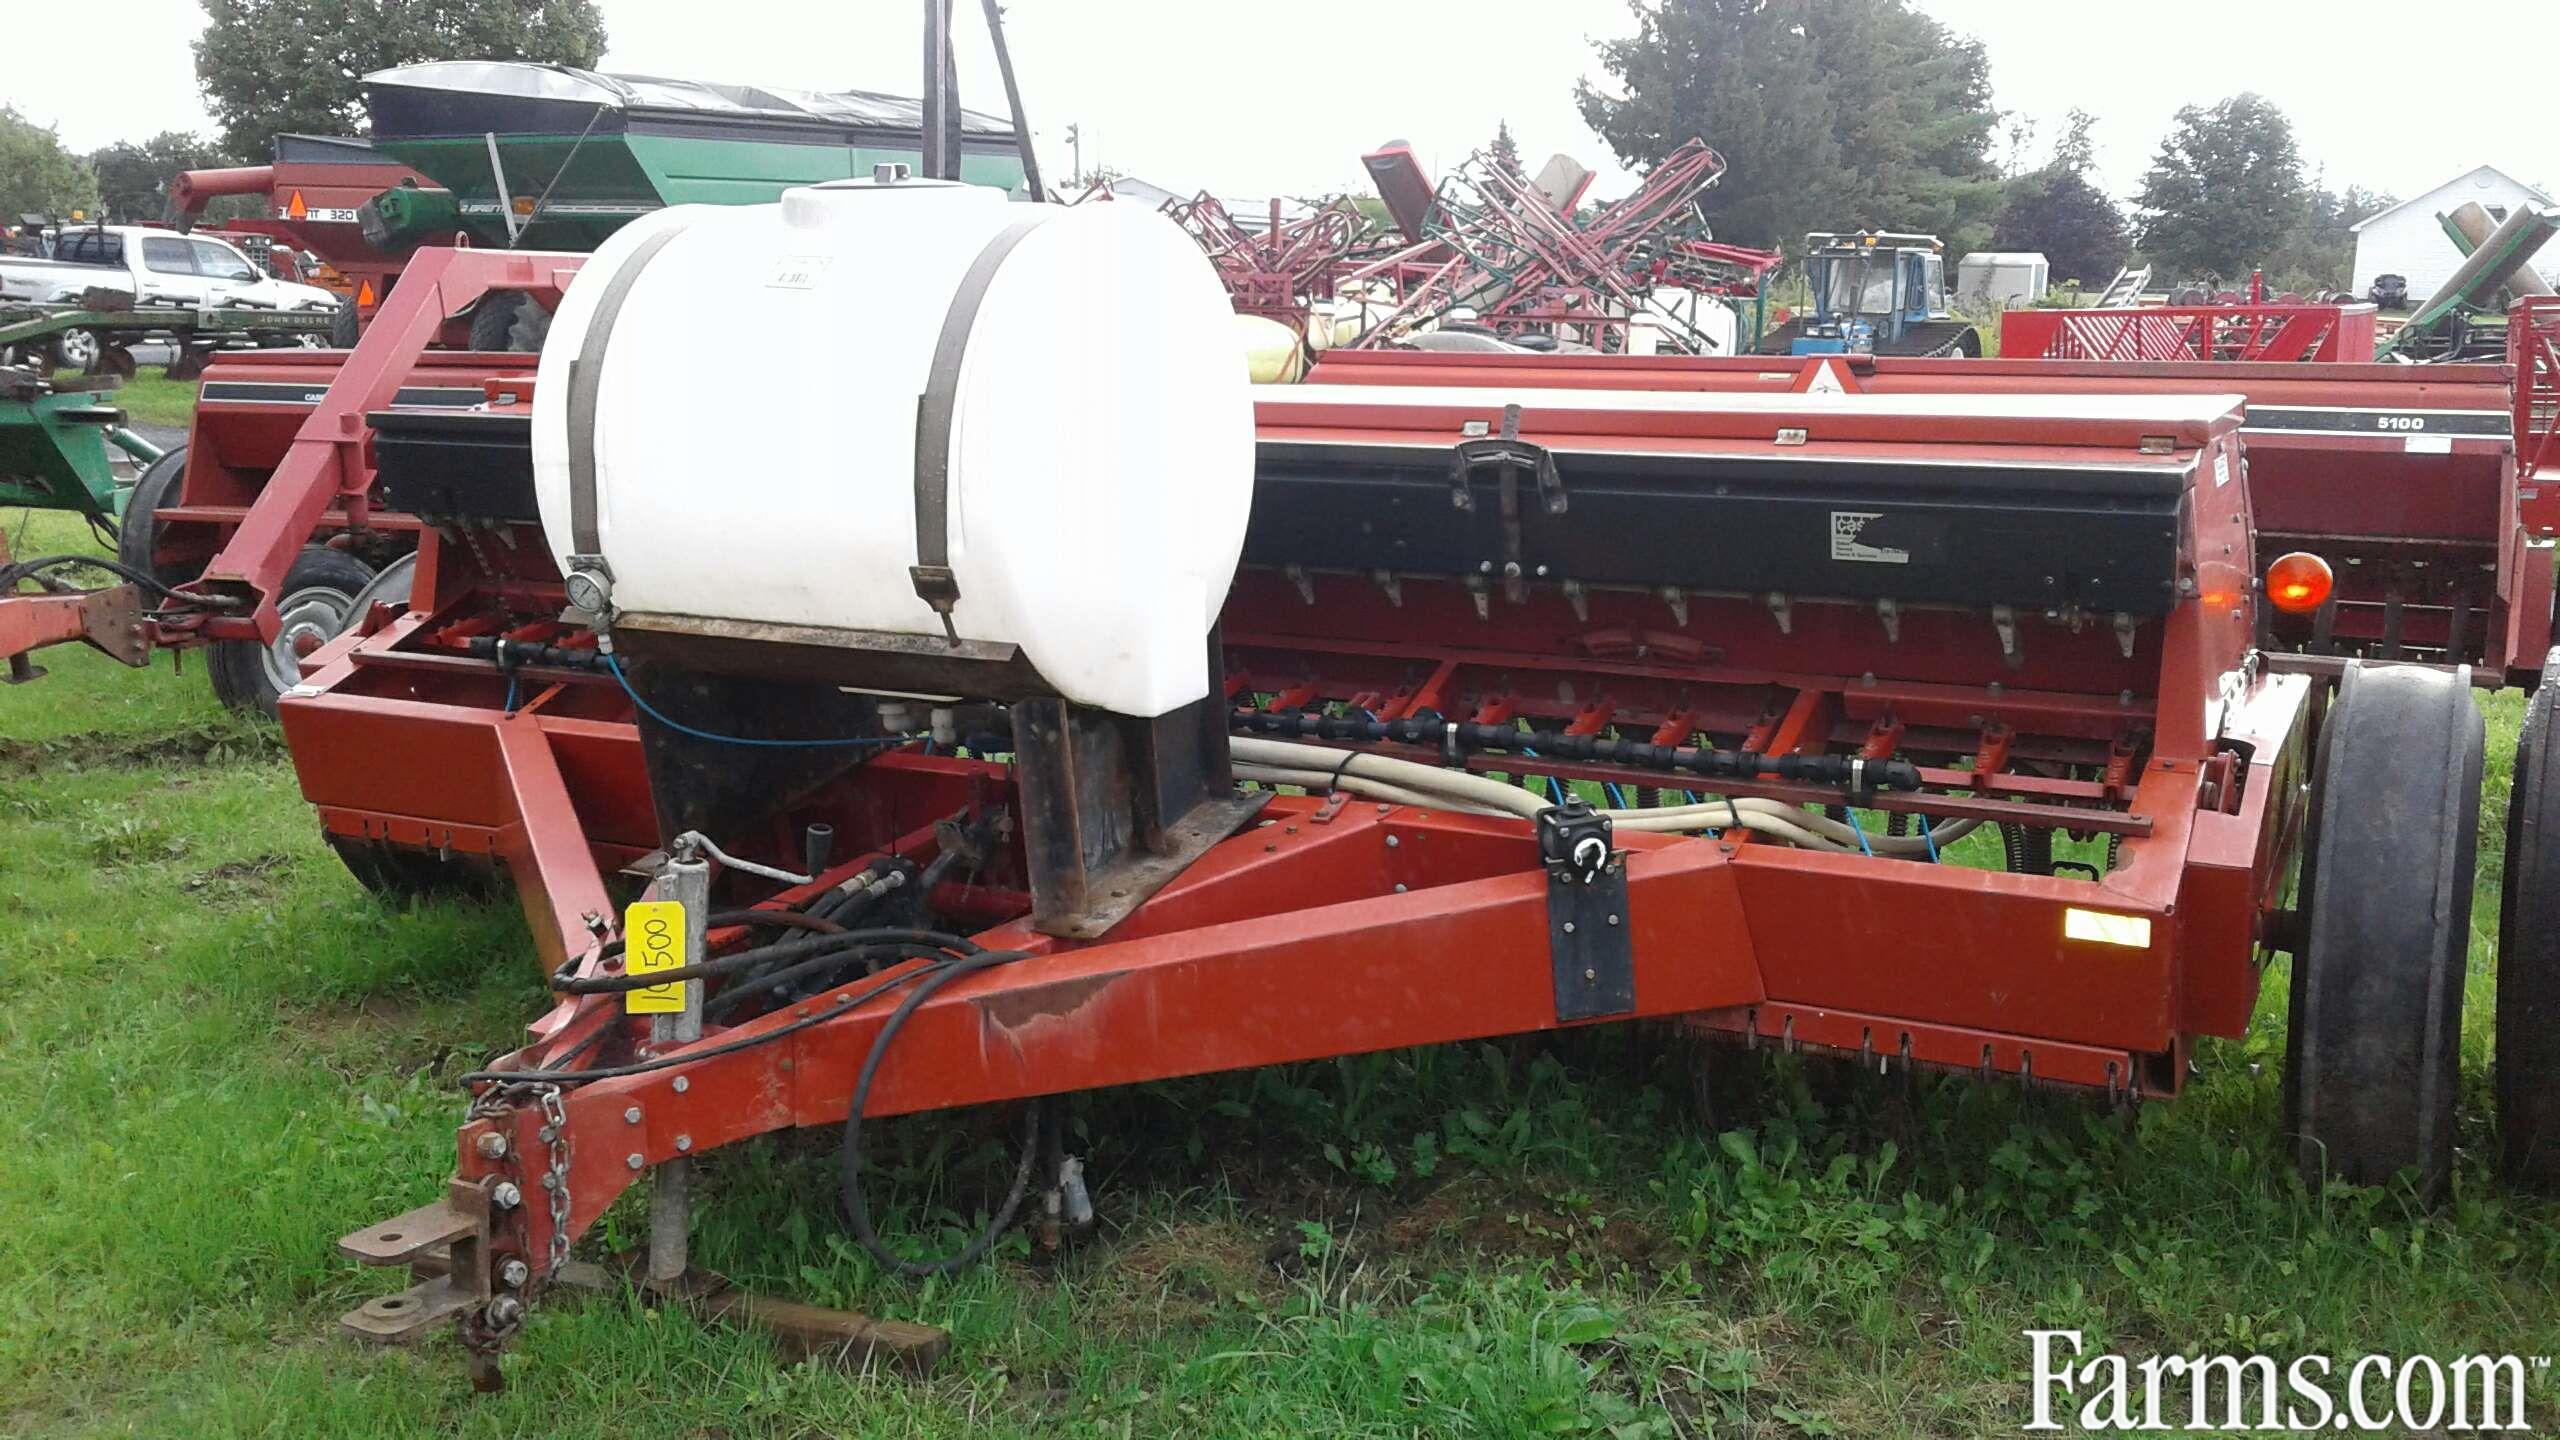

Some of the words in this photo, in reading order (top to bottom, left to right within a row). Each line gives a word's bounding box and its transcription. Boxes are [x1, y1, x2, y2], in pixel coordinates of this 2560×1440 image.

[330, 210, 354, 220] 320
[261, 315, 288, 324] JOHN
[294, 316, 330, 325] DEERE
[2377, 417, 2425, 430] 5100
